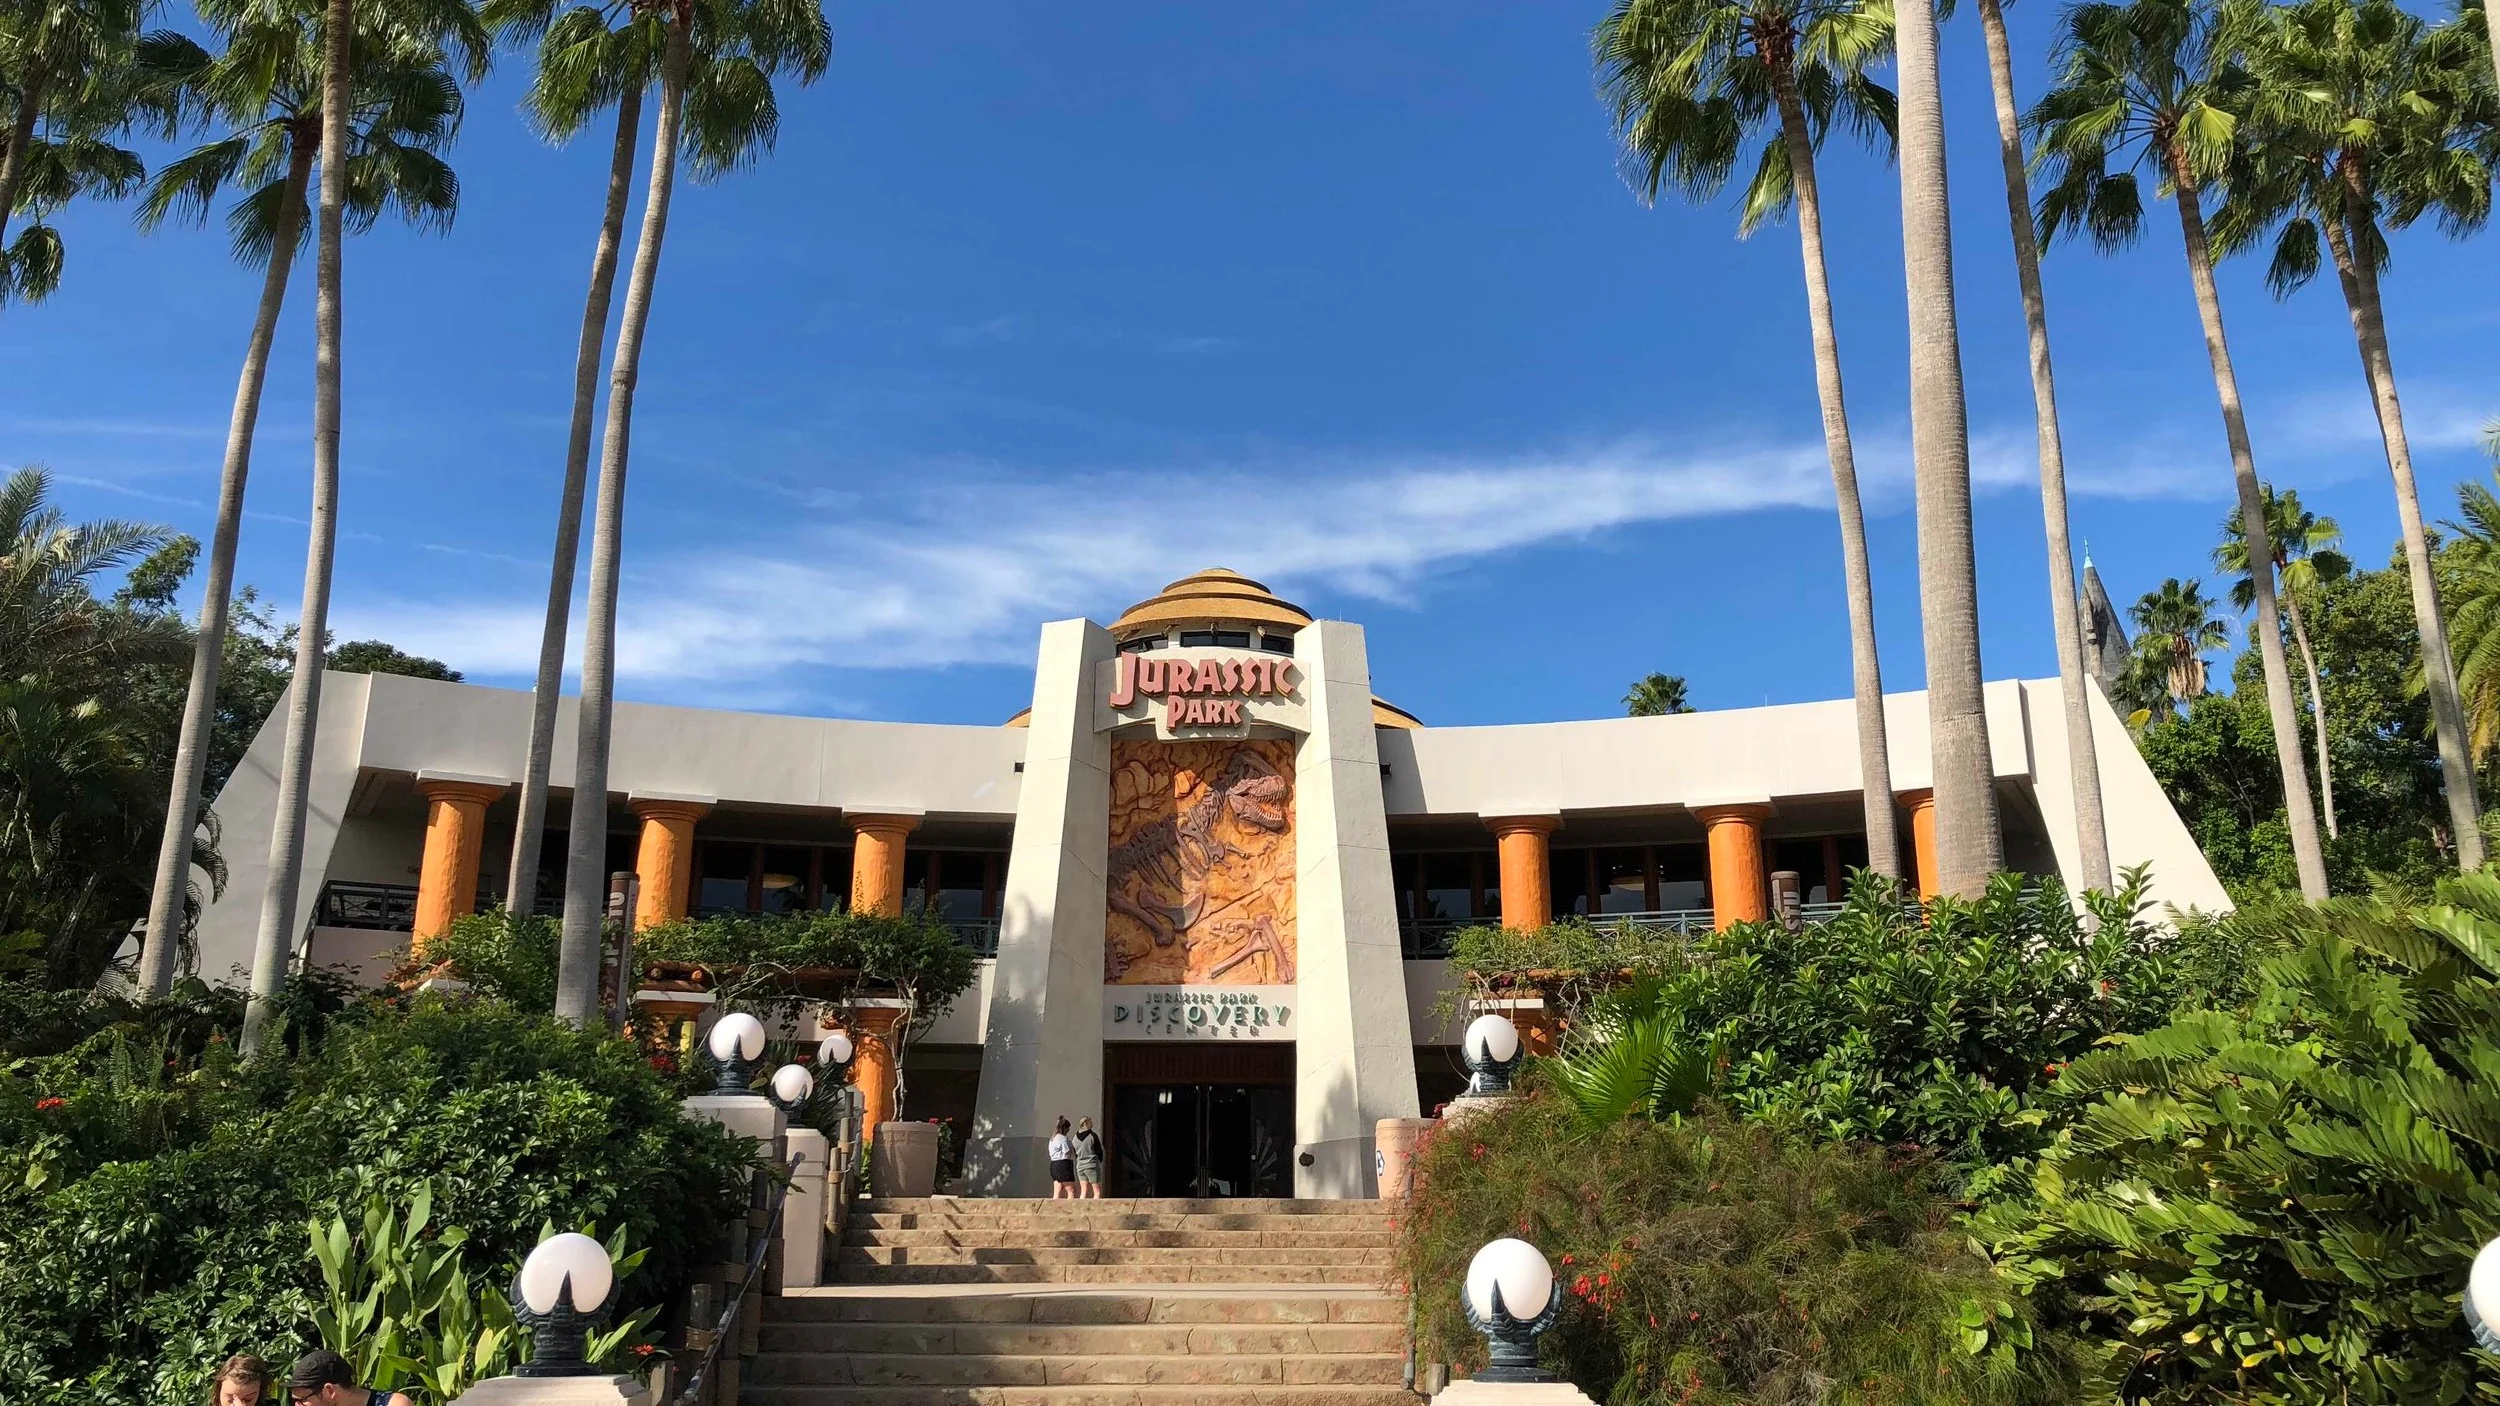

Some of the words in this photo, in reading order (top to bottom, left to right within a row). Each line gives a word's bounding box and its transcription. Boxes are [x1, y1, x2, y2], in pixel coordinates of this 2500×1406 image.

[1110, 651, 1293, 708] JURASSIC
[1166, 694, 1244, 731] PARK
[1145, 992, 1214, 1005] JURASSIC
[1220, 992, 1258, 1005] PARK
[1114, 1005, 1288, 1026] DISCOVERY
[1146, 1025, 1260, 1037] CENTER
